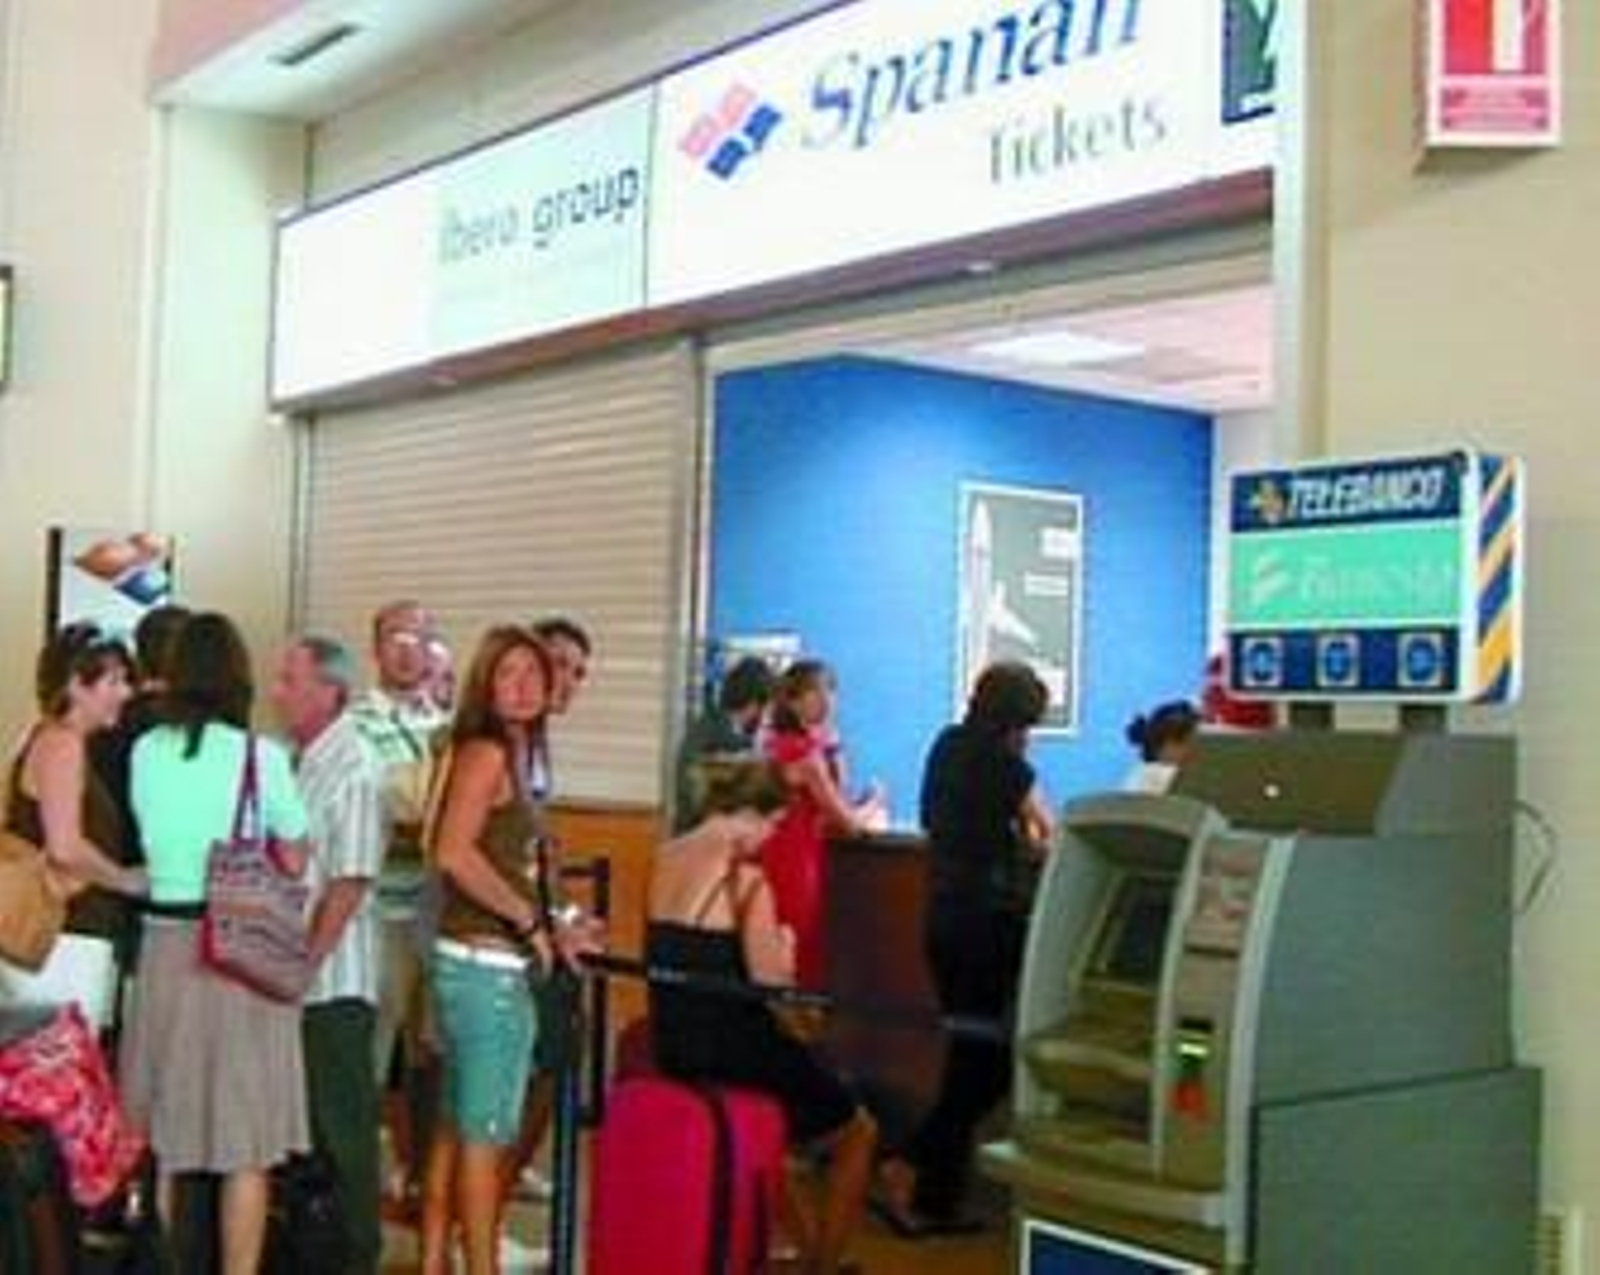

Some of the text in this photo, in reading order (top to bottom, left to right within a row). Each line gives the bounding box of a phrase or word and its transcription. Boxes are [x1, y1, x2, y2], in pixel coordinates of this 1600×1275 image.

[990, 98, 1167, 185] Tickets
[532, 168, 639, 248] group
[1288, 467, 1444, 519] TELEBANCO
